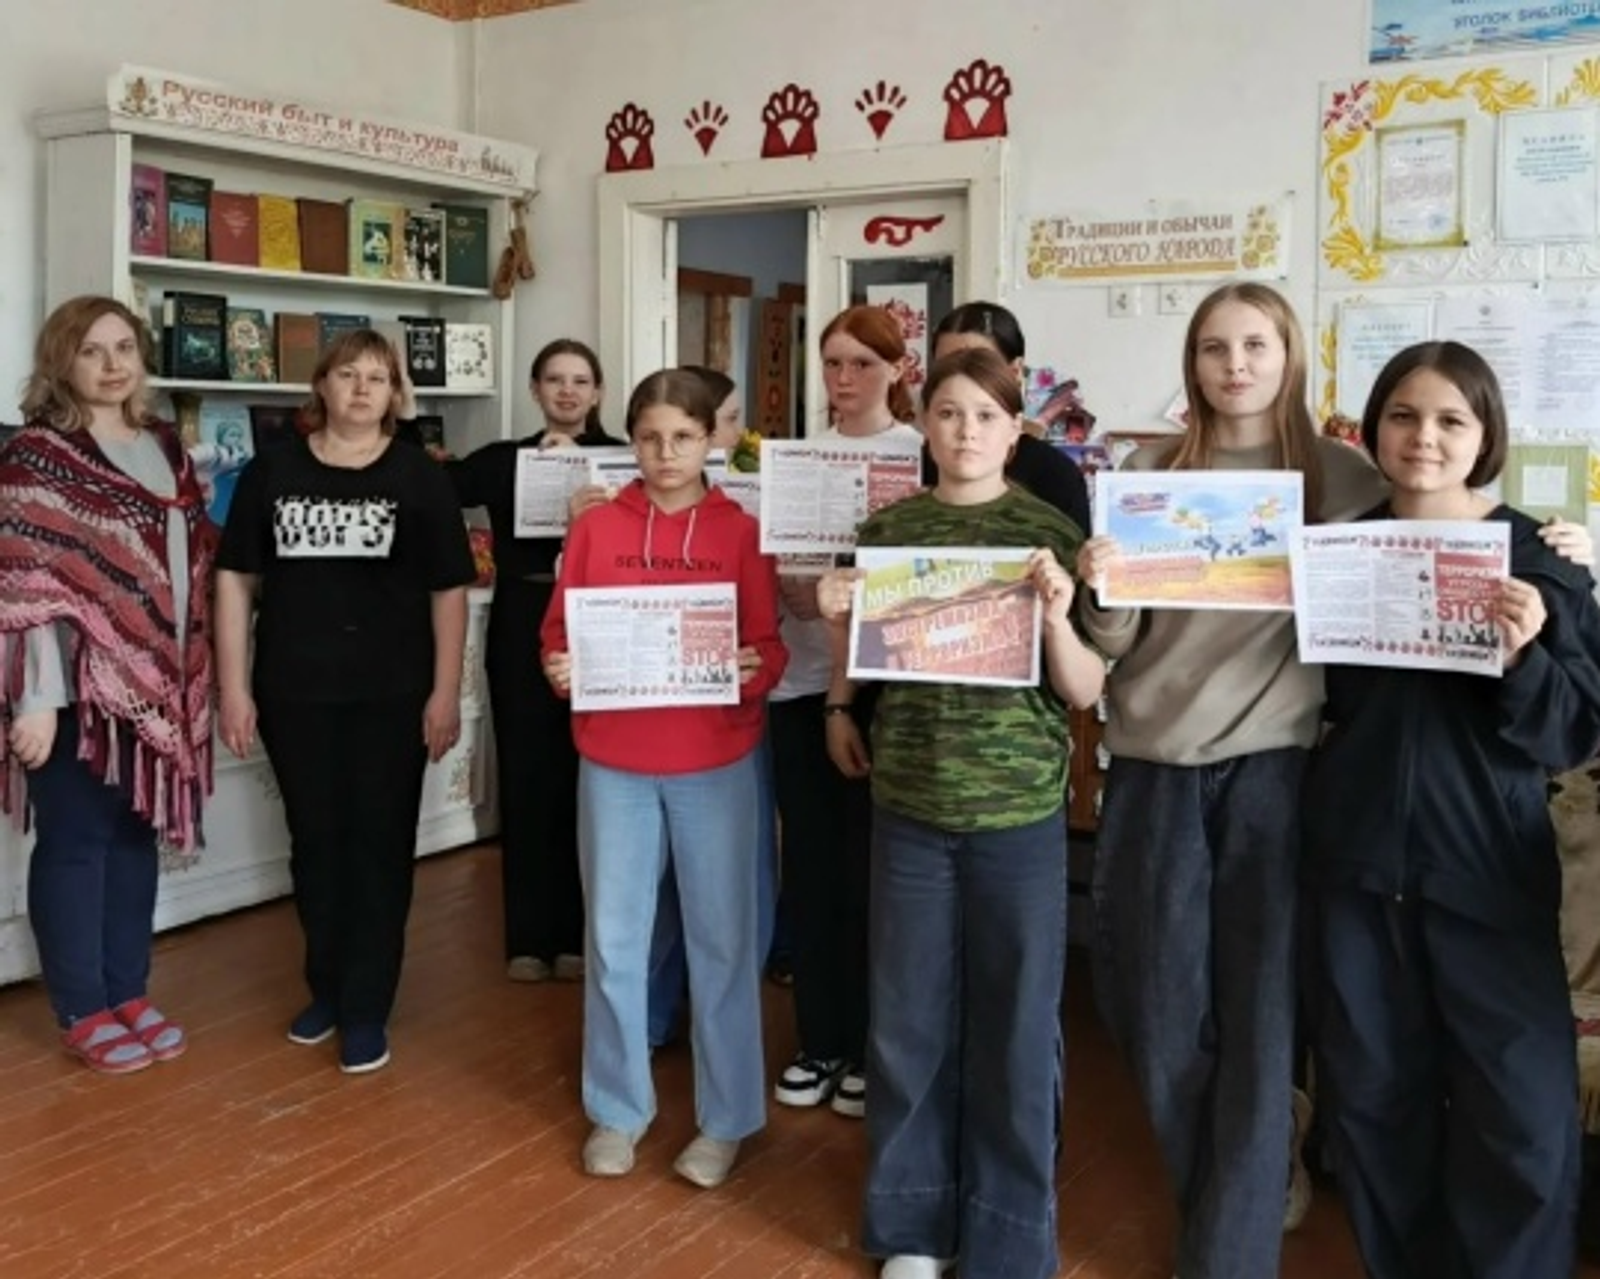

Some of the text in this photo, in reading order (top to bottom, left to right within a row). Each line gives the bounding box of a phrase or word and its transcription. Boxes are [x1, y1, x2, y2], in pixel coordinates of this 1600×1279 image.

[162, 80, 459, 152] Русский быт и культура
[615, 555, 722, 571] SEVENTEEN
